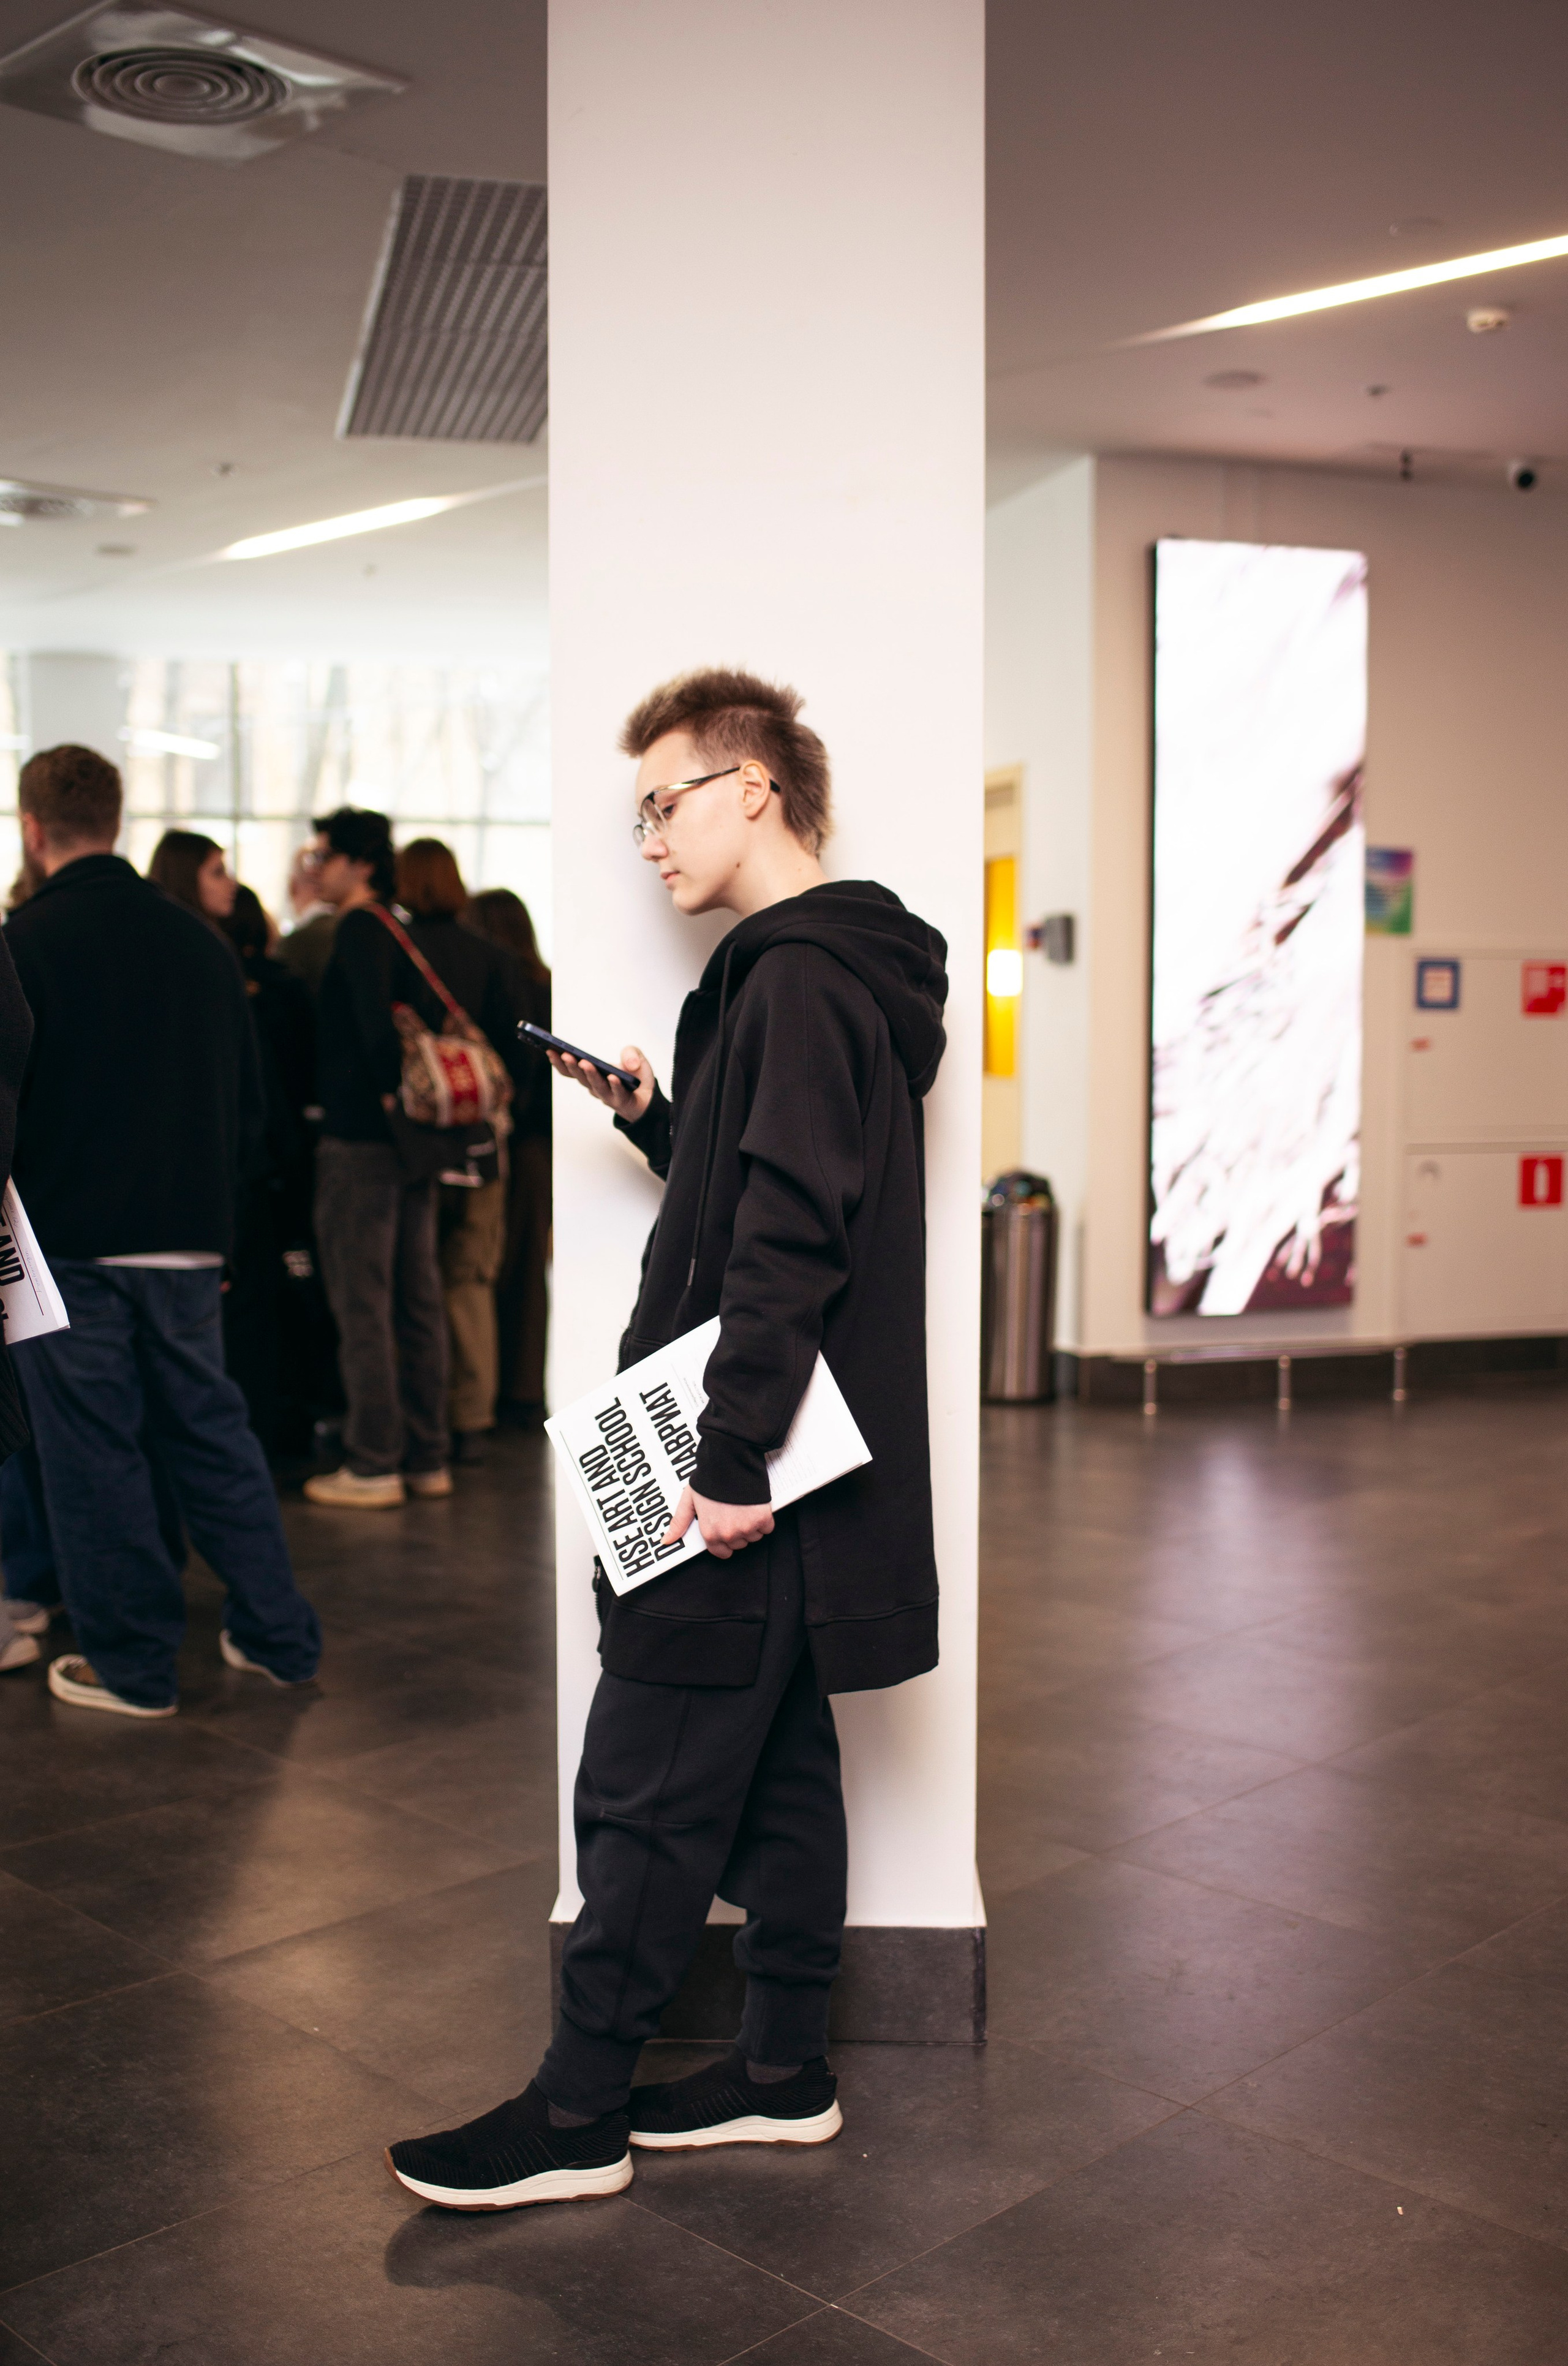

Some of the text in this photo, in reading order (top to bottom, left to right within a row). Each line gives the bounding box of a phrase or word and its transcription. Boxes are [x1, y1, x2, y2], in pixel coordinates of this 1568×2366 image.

[595, 1397, 651, 1486] SCHOOL
[639, 1382, 697, 1483] ЛАВРИАТ
[579, 1445, 655, 1578] HSE ART AND
